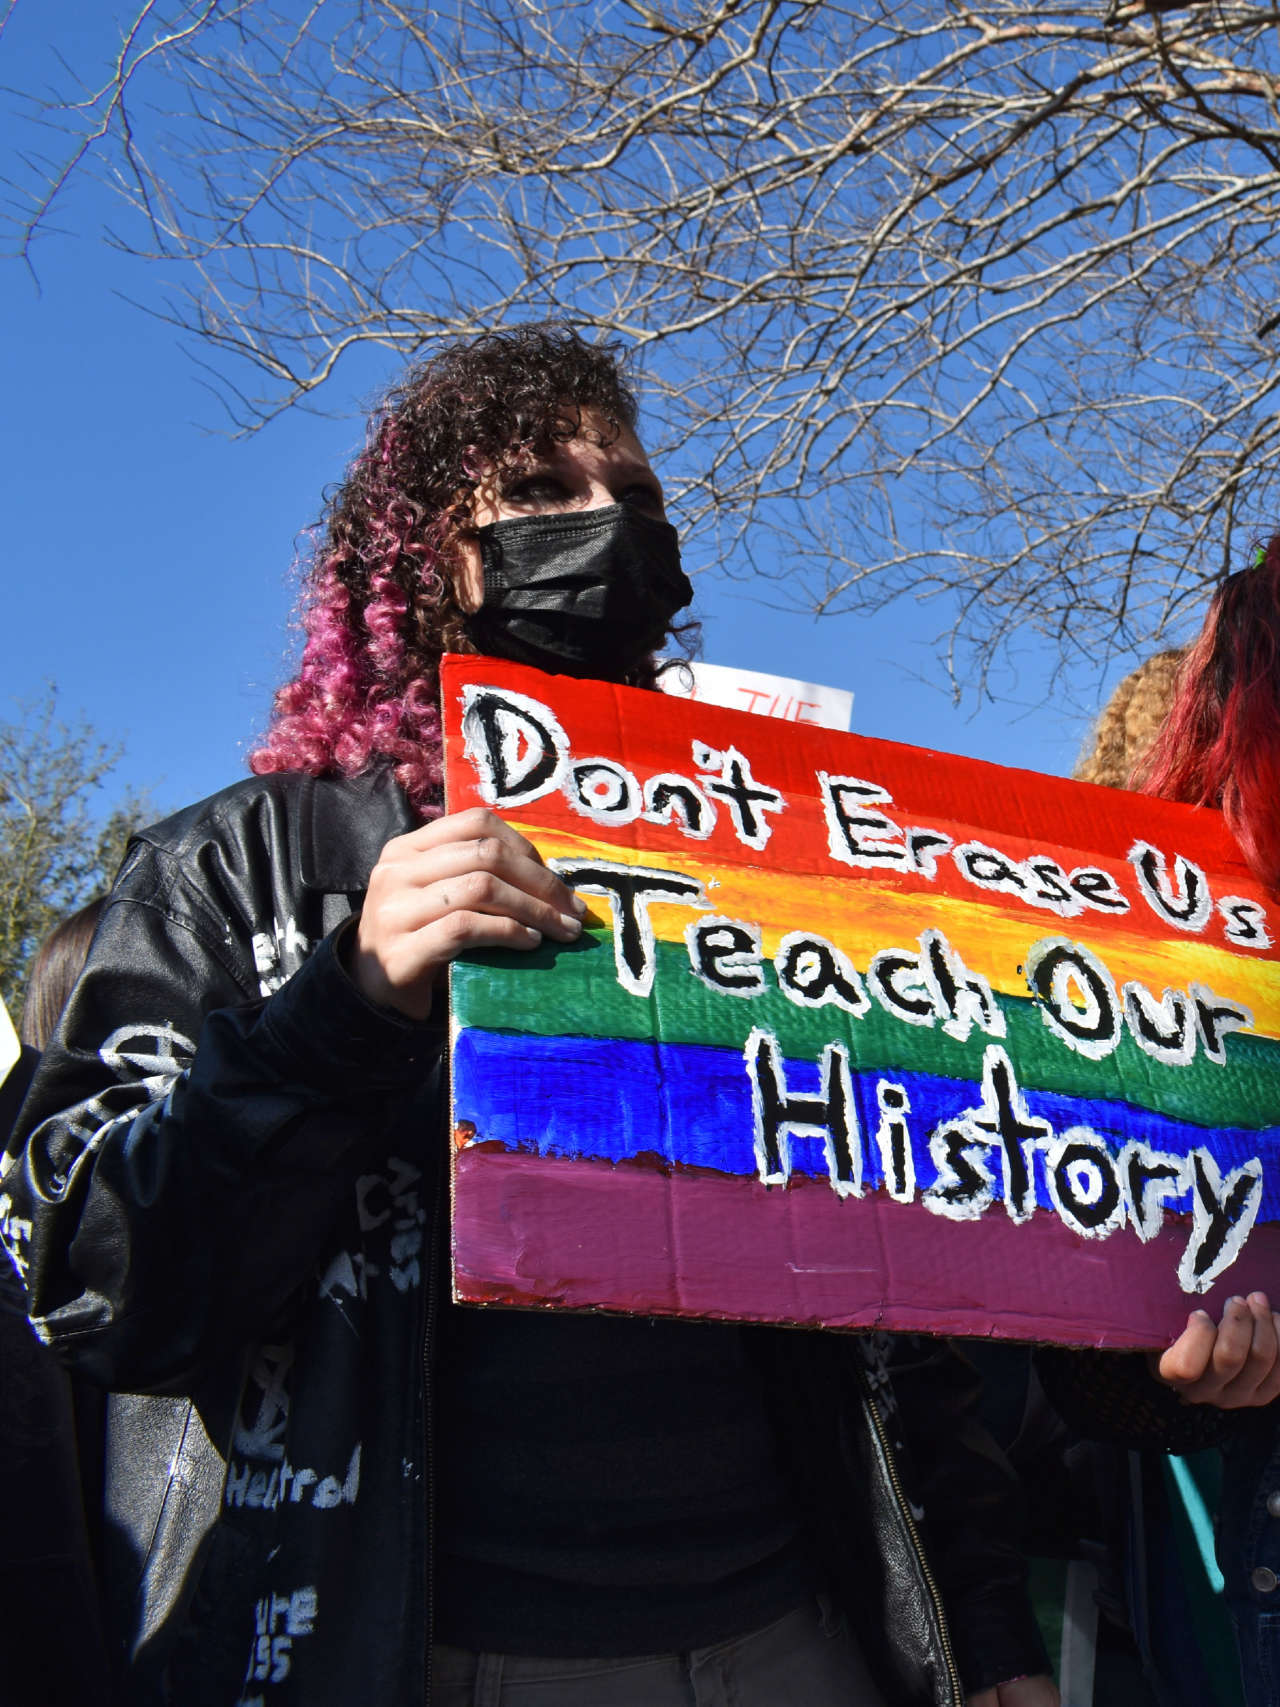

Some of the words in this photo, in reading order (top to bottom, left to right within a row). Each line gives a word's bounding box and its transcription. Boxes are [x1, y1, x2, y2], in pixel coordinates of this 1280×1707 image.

[457, 684, 788, 851] Don't
[815, 770, 1130, 917] Erase
[1127, 840, 1275, 949] Us
[547, 857, 1006, 1042] Teach
[1027, 936, 1254, 1067] Our
[744, 1026, 1263, 1293] History
